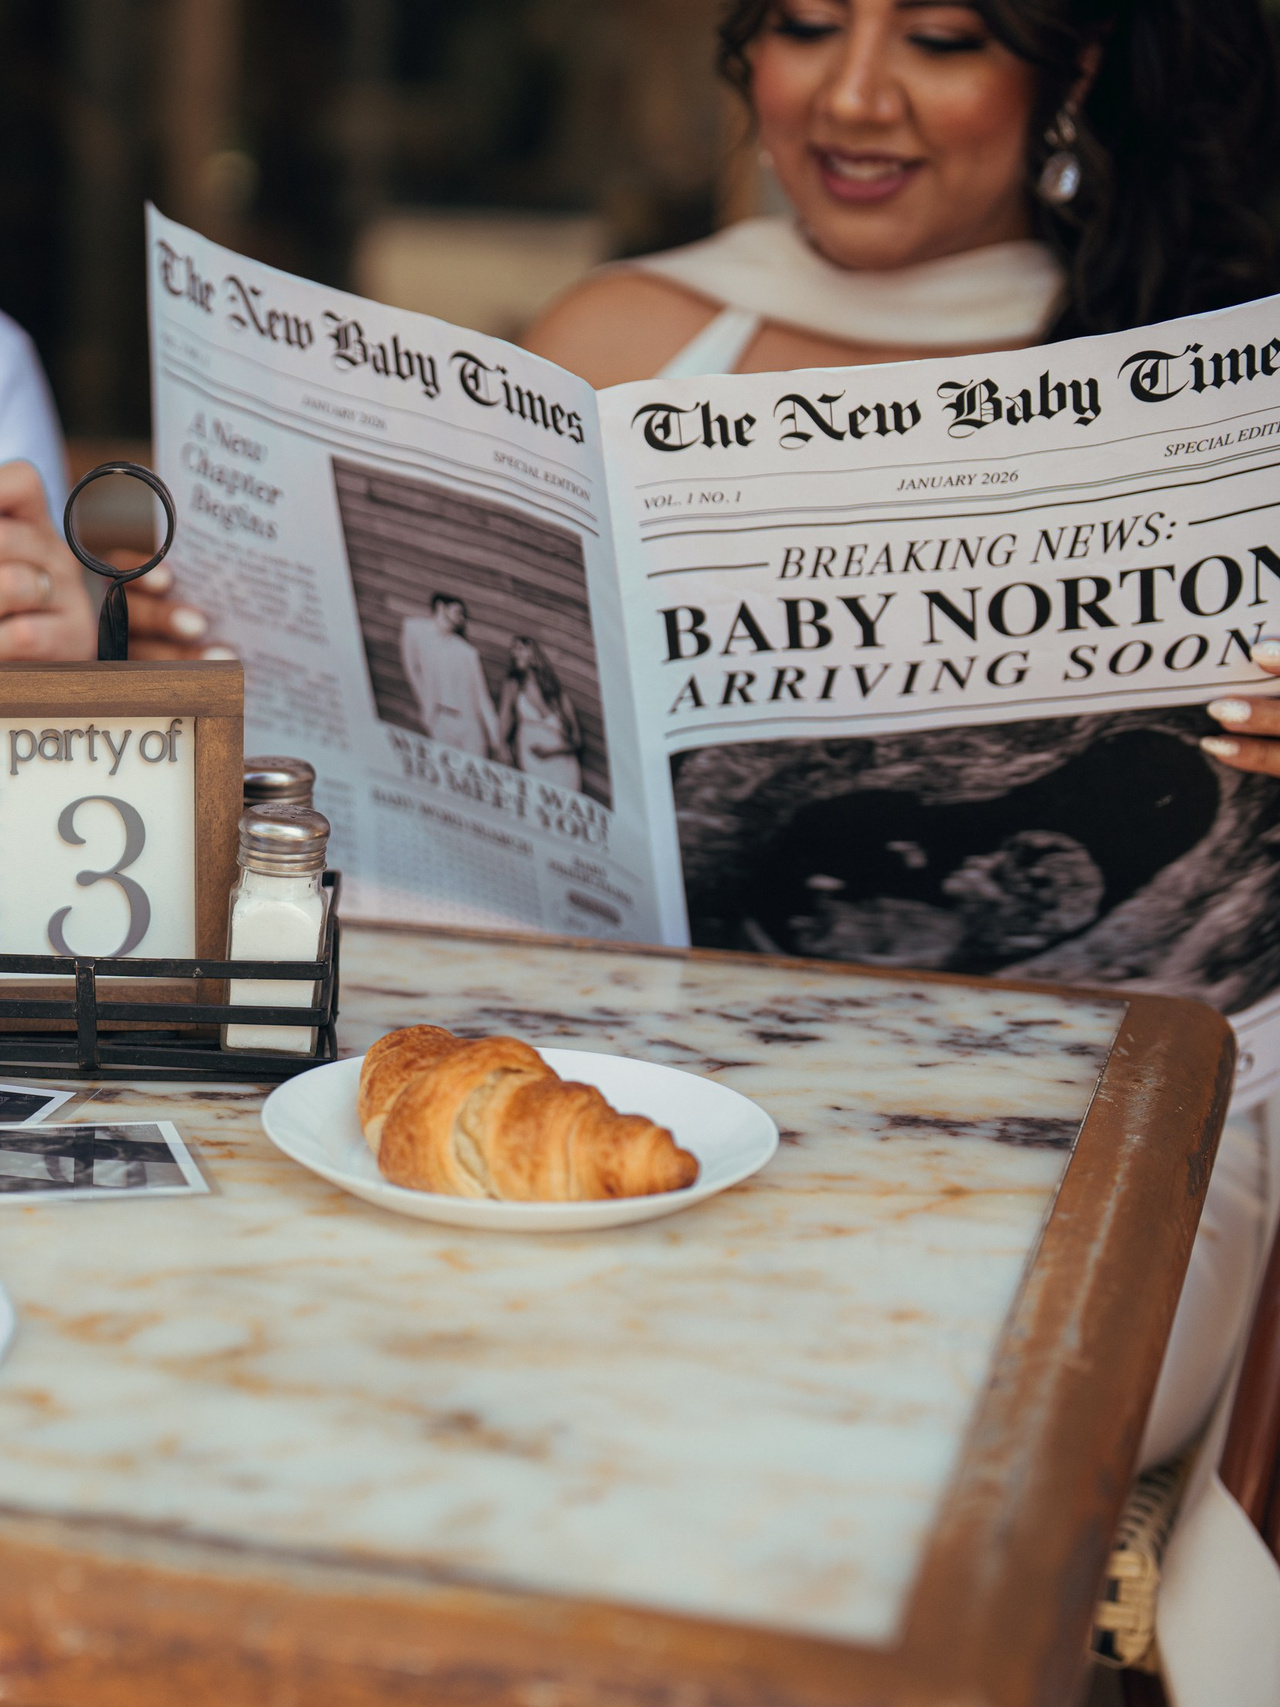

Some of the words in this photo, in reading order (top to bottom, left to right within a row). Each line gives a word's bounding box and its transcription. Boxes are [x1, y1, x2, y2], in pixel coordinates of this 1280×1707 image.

[157, 237, 216, 315] The
[223, 274, 315, 352] New
[321, 309, 442, 402] Baby
[450, 350, 586, 446] Times
[188, 411, 207, 439] A
[212, 415, 268, 463] New
[632, 401, 757, 453] The
[773, 389, 923, 451] New
[936, 369, 1102, 440] Baby
[180, 441, 284, 505] Chapter
[493, 450, 540, 481] SPECIAL
[543, 466, 592, 502] EDITION
[1164, 433, 1234, 457] SPECIAL
[188, 481, 278, 541] Begins
[644, 494, 682, 510] VOL.
[700, 491, 730, 504] NO.
[897, 473, 977, 491] JANUARY
[981, 469, 1019, 485] 2026
[776, 532, 1017, 580] BREAKING
[1030, 512, 1177, 563] NEWS:
[657, 591, 897, 664] BABY
[667, 648, 1031, 716] ARRIVING
[10, 723, 132, 776] party
[139, 719, 184, 763] of
[47, 794, 151, 957] 3
